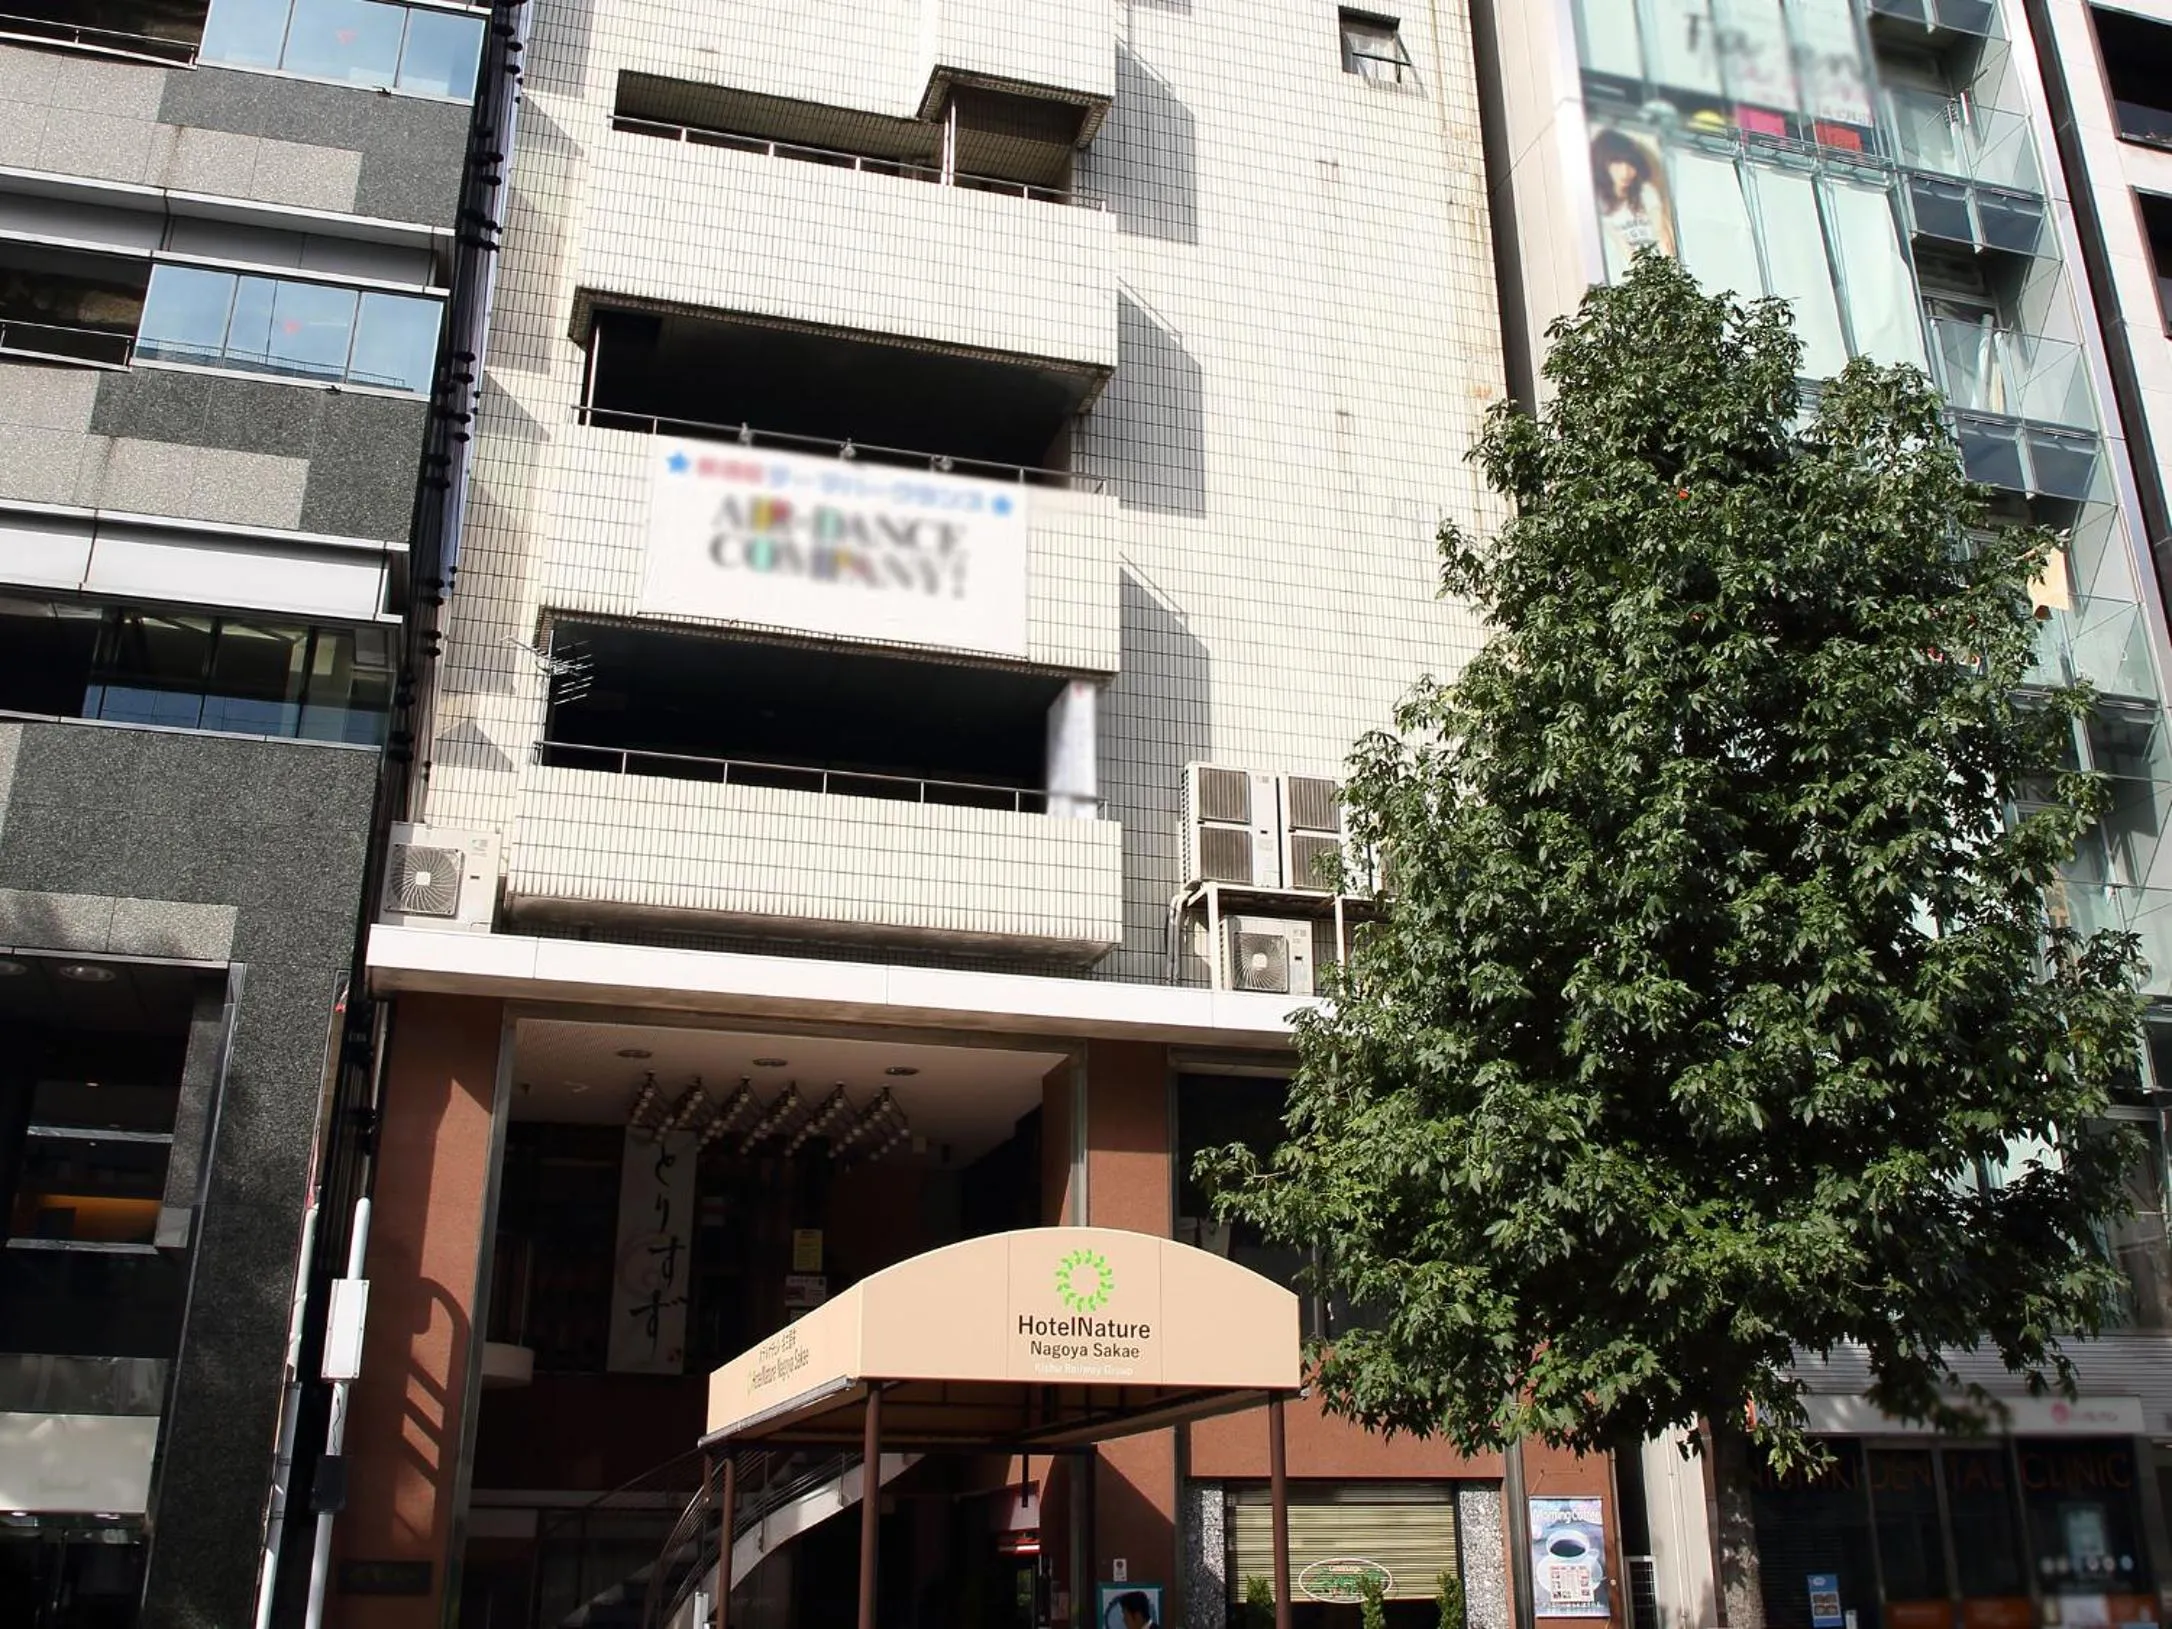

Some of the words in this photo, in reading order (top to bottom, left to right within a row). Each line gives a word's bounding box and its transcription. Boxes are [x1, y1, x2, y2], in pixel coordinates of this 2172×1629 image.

[1019, 1314, 1151, 1339] HotelNature
[1030, 1341, 1088, 1359] Nagoya
[1093, 1342, 1140, 1359] Sakae
[2021, 1450, 2133, 1491] CLINIC
